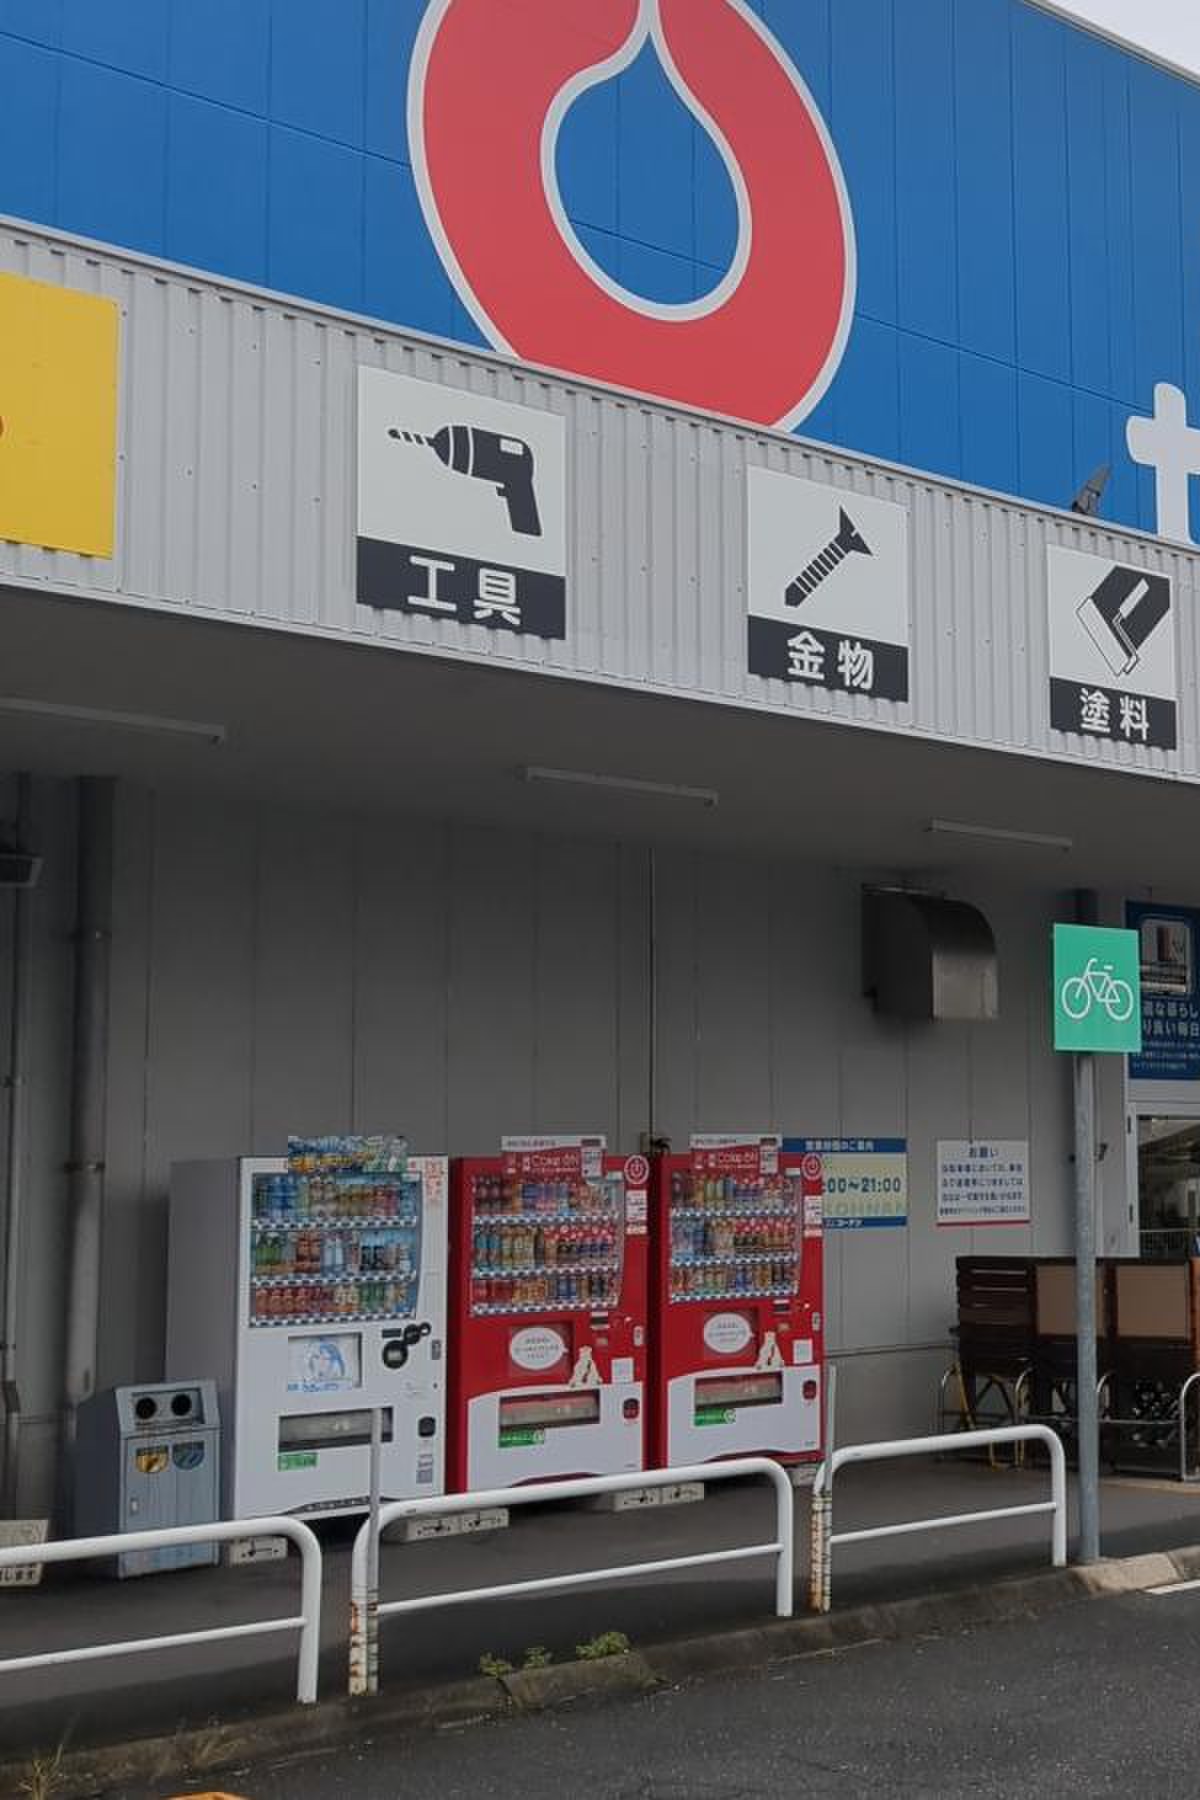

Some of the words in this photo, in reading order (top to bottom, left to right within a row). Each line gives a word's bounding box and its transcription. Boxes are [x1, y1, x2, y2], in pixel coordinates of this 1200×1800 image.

[407, 554, 521, 625] 工具
[786, 630, 875, 690] 金物
[1079, 686, 1151, 742] 塗料
